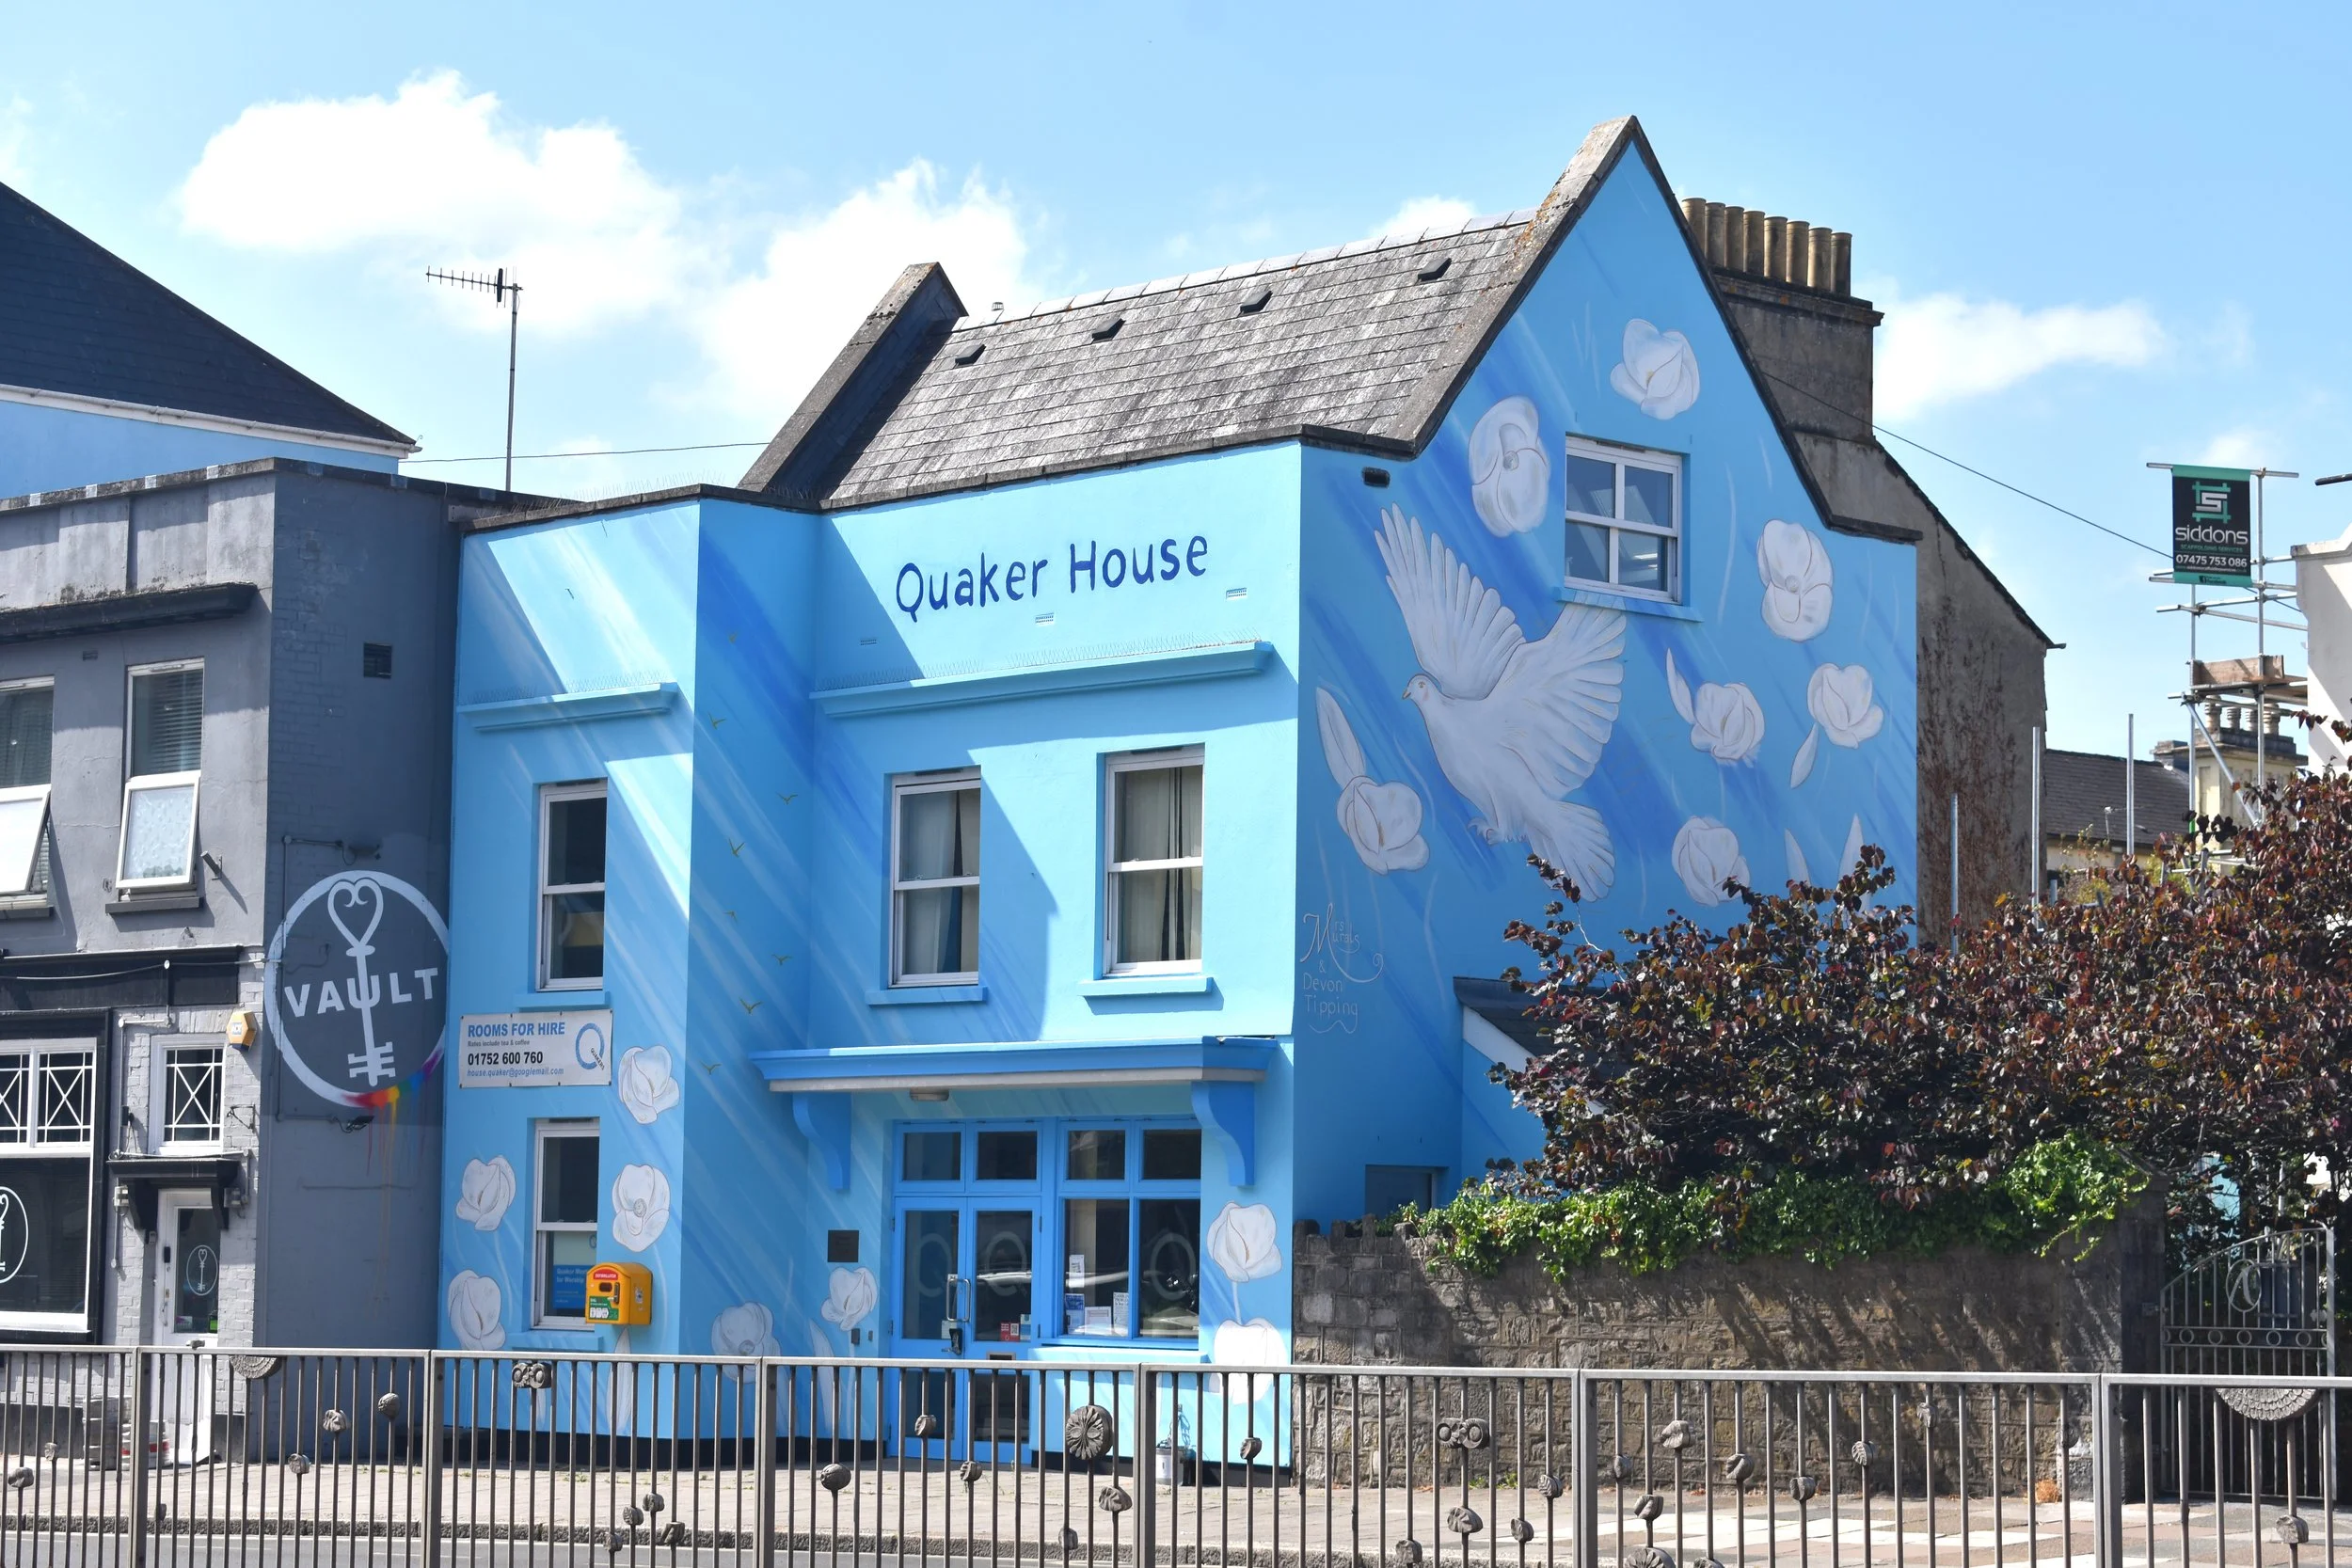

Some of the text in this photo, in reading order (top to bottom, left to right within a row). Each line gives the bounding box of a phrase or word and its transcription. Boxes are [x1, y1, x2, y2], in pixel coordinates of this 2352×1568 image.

[2174, 525, 2248, 545] siddons
[2175, 554, 2248, 568] 07475 753 086
[896, 535, 1208, 624] Quaker House
[1303, 972, 1343, 992] Devon
[283, 967, 438, 1018] VAULT
[1304, 994, 1359, 1034] Tipping
[468, 1022, 565, 1037] ROOMS FOR HIRE
[468, 1051, 544, 1066] 01752 600 760
[467, 1066, 564, 1078] house.quaker@googlemail.com
